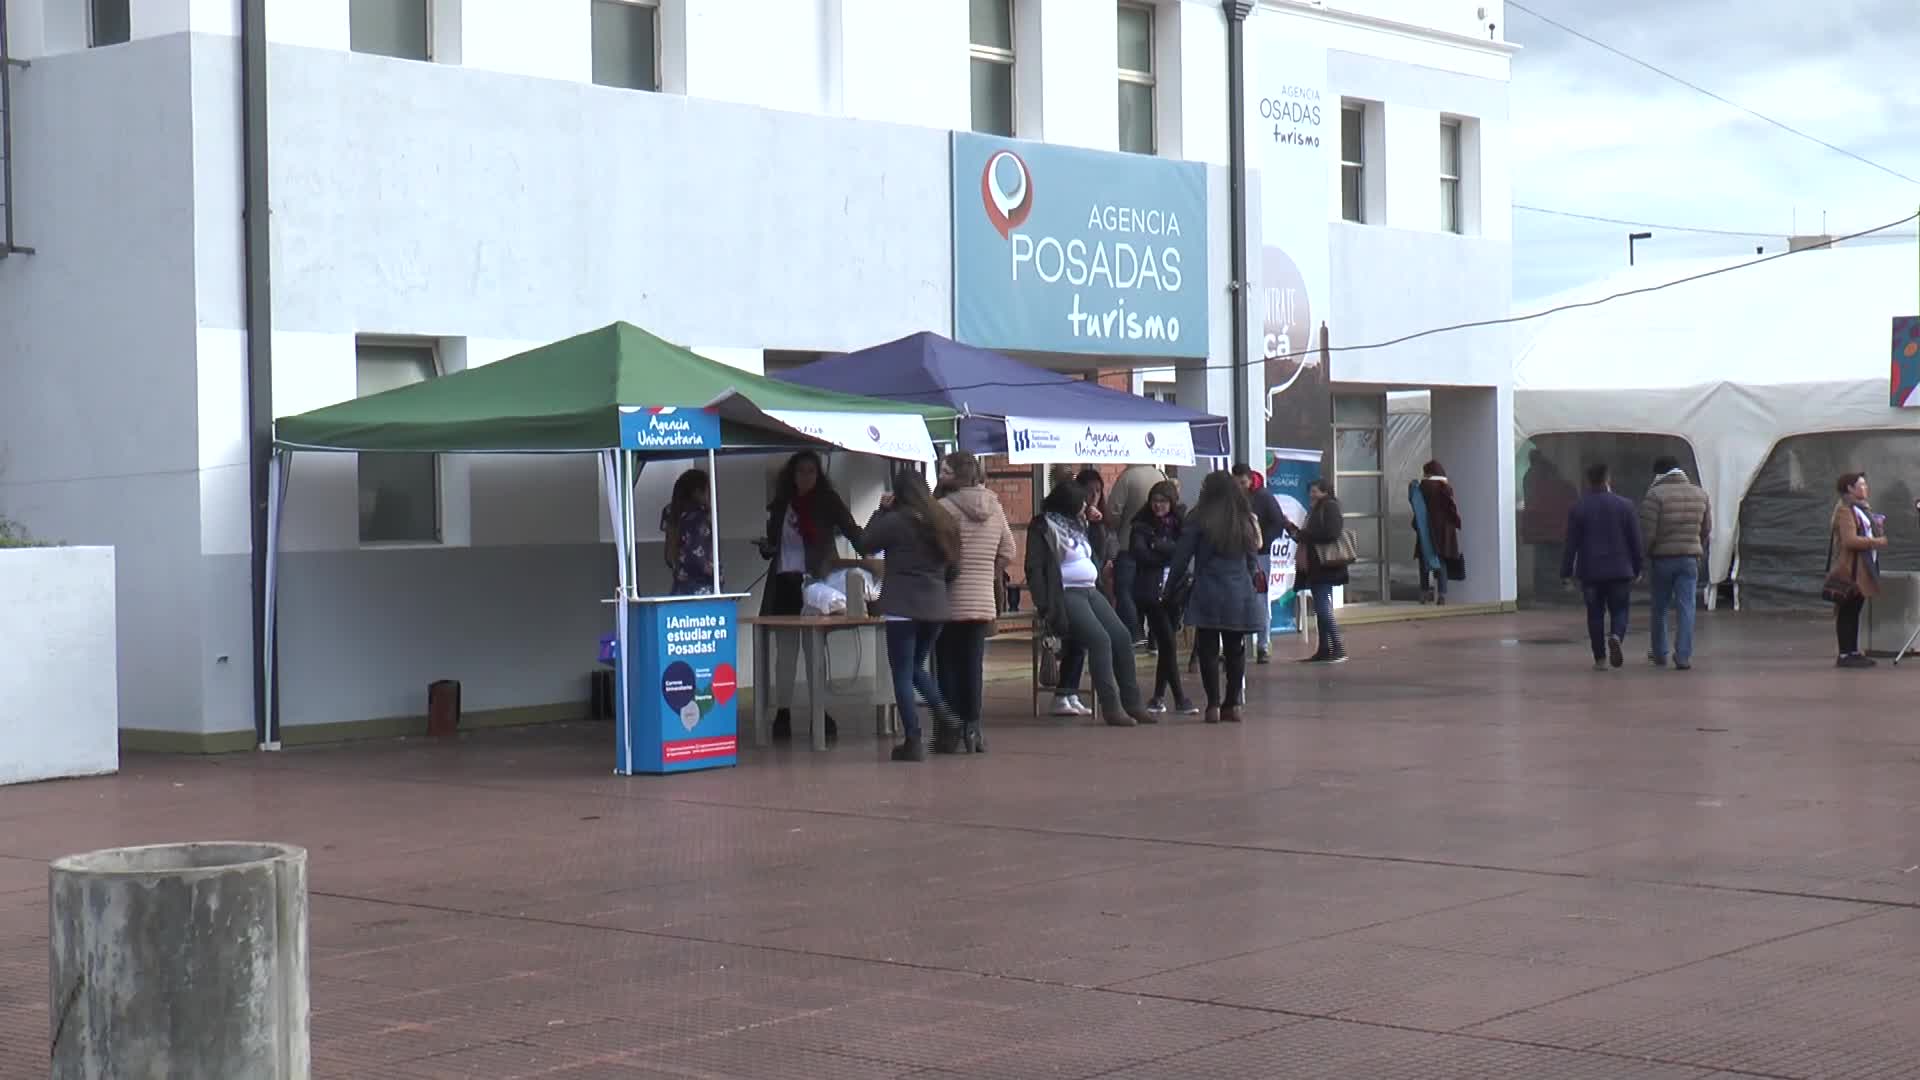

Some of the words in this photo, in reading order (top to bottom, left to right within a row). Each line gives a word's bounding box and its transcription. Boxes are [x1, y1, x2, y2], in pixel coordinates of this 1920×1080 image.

[1281, 84, 1320, 101] AGENCIA
[1273, 123, 1320, 148] turismo
[1088, 204, 1181, 237] AGENCIA
[1012, 233, 1182, 292] POSADAS
[1067, 293, 1180, 342] turismo
[649, 414, 690, 435] Agencia
[637, 430, 703, 446] Universitaria
[1085, 426, 1120, 446] Agencia
[1074, 442, 1131, 458] Universitaria
[667, 615, 717, 629] ¡Animate
[718, 616, 726, 627] a
[666, 628, 713, 642] estudiar
[714, 629, 727, 640] en
[667, 641, 716, 656] Posadas!
